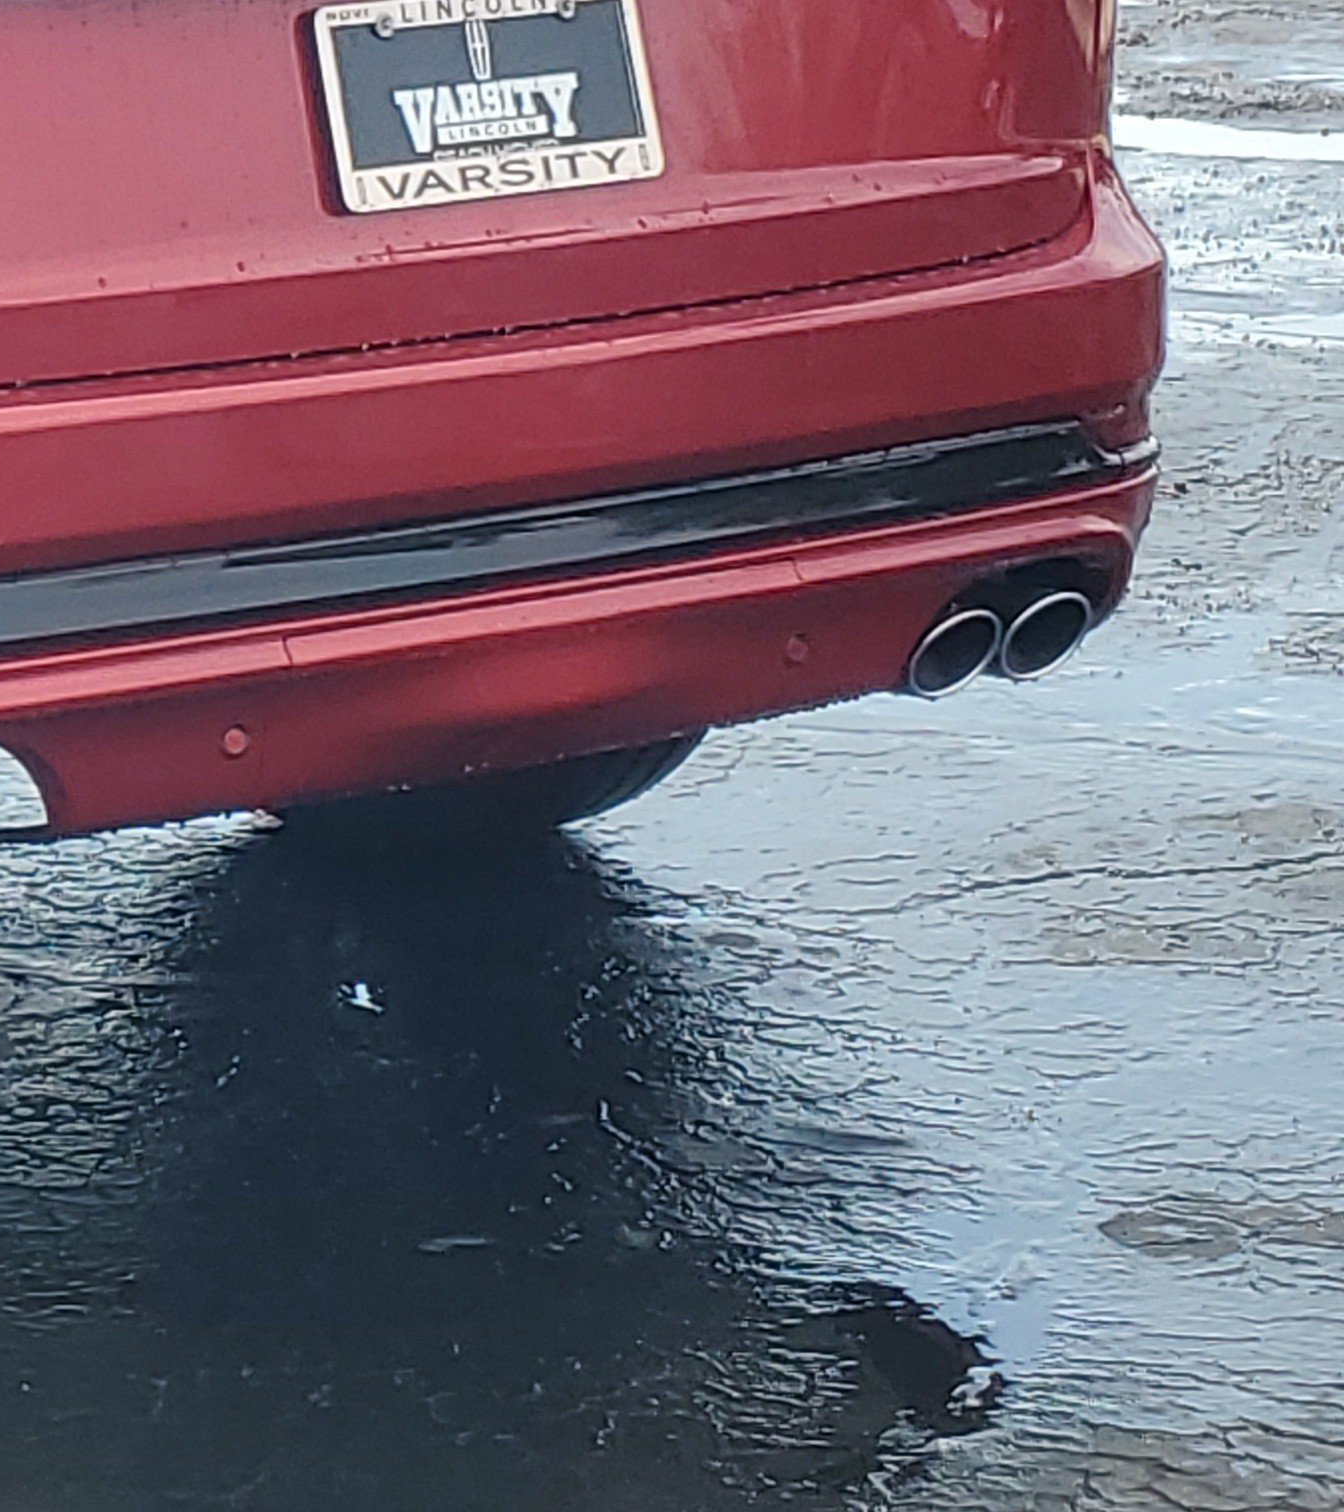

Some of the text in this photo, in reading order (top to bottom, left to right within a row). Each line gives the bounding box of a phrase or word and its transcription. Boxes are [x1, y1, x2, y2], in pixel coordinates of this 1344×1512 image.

[392, 71, 580, 155] VARSITY
[448, 120, 538, 141] LINCOLN
[376, 146, 627, 201] VARSITY
